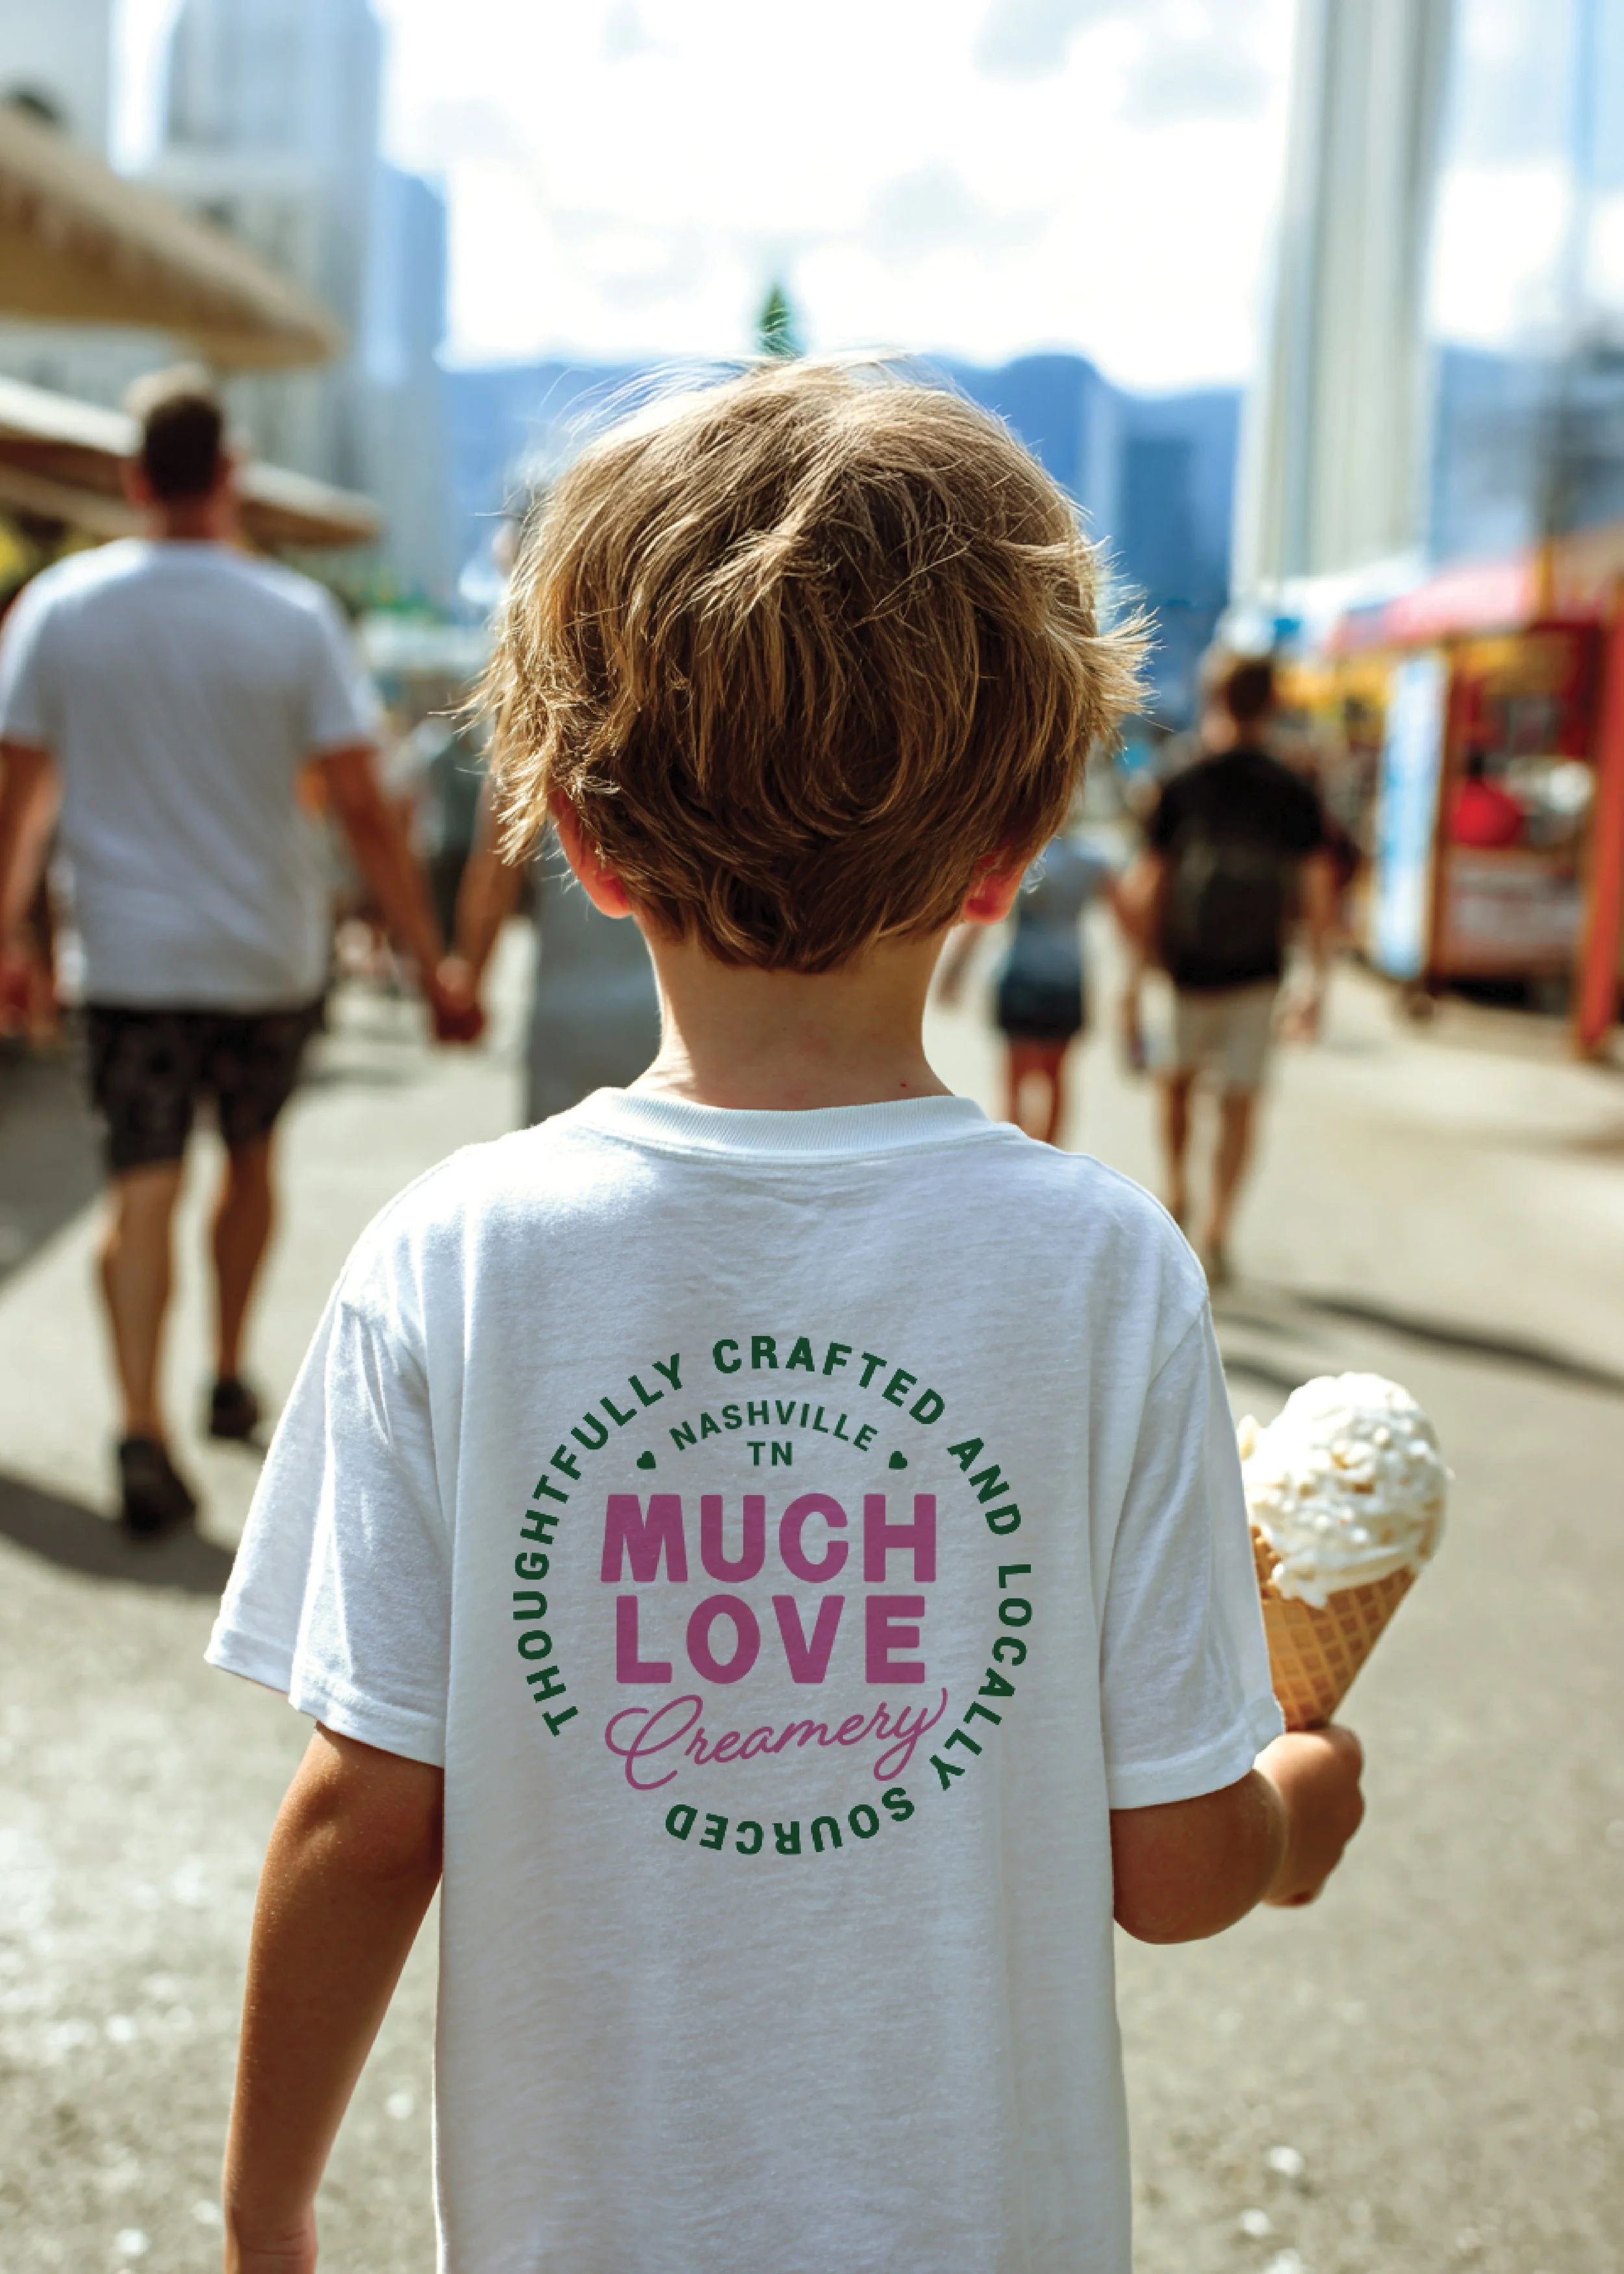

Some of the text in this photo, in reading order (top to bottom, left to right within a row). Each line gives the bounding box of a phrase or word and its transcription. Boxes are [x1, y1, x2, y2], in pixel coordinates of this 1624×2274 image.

[670, 1399, 878, 1451] NASHVILLE
[748, 1440, 794, 1466] TN
[600, 1493, 937, 1583] MUCH
[513, 1336, 1032, 1855] THOUGHTFULLY CRAFTED AND LOCALLY SOURCED
[616, 1594, 926, 1684] LOVE
[604, 1687, 948, 1790] Creamery
